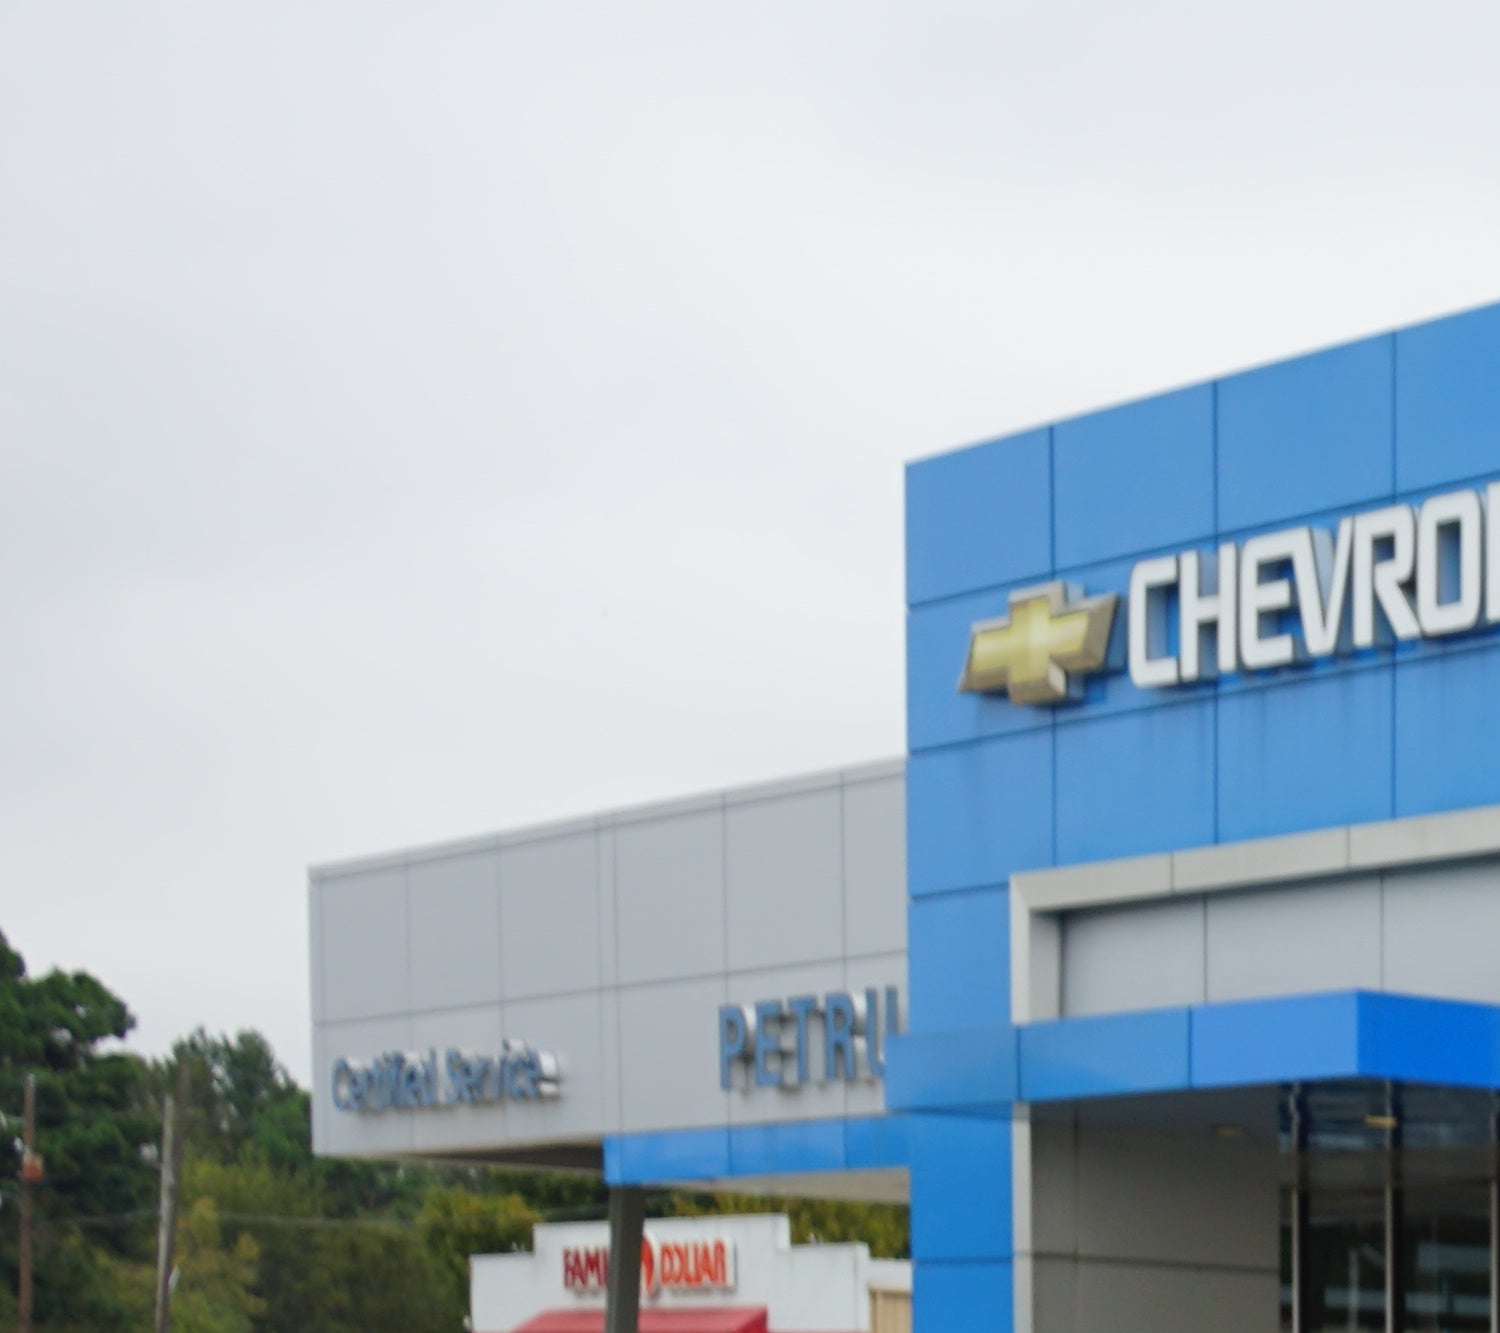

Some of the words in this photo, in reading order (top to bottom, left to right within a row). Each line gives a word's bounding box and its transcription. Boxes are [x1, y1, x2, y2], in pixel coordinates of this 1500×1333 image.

[444, 1038, 556, 1105] Service
[563, 1246, 609, 1288] FAMI
[659, 1238, 728, 1287] DOLLAR
